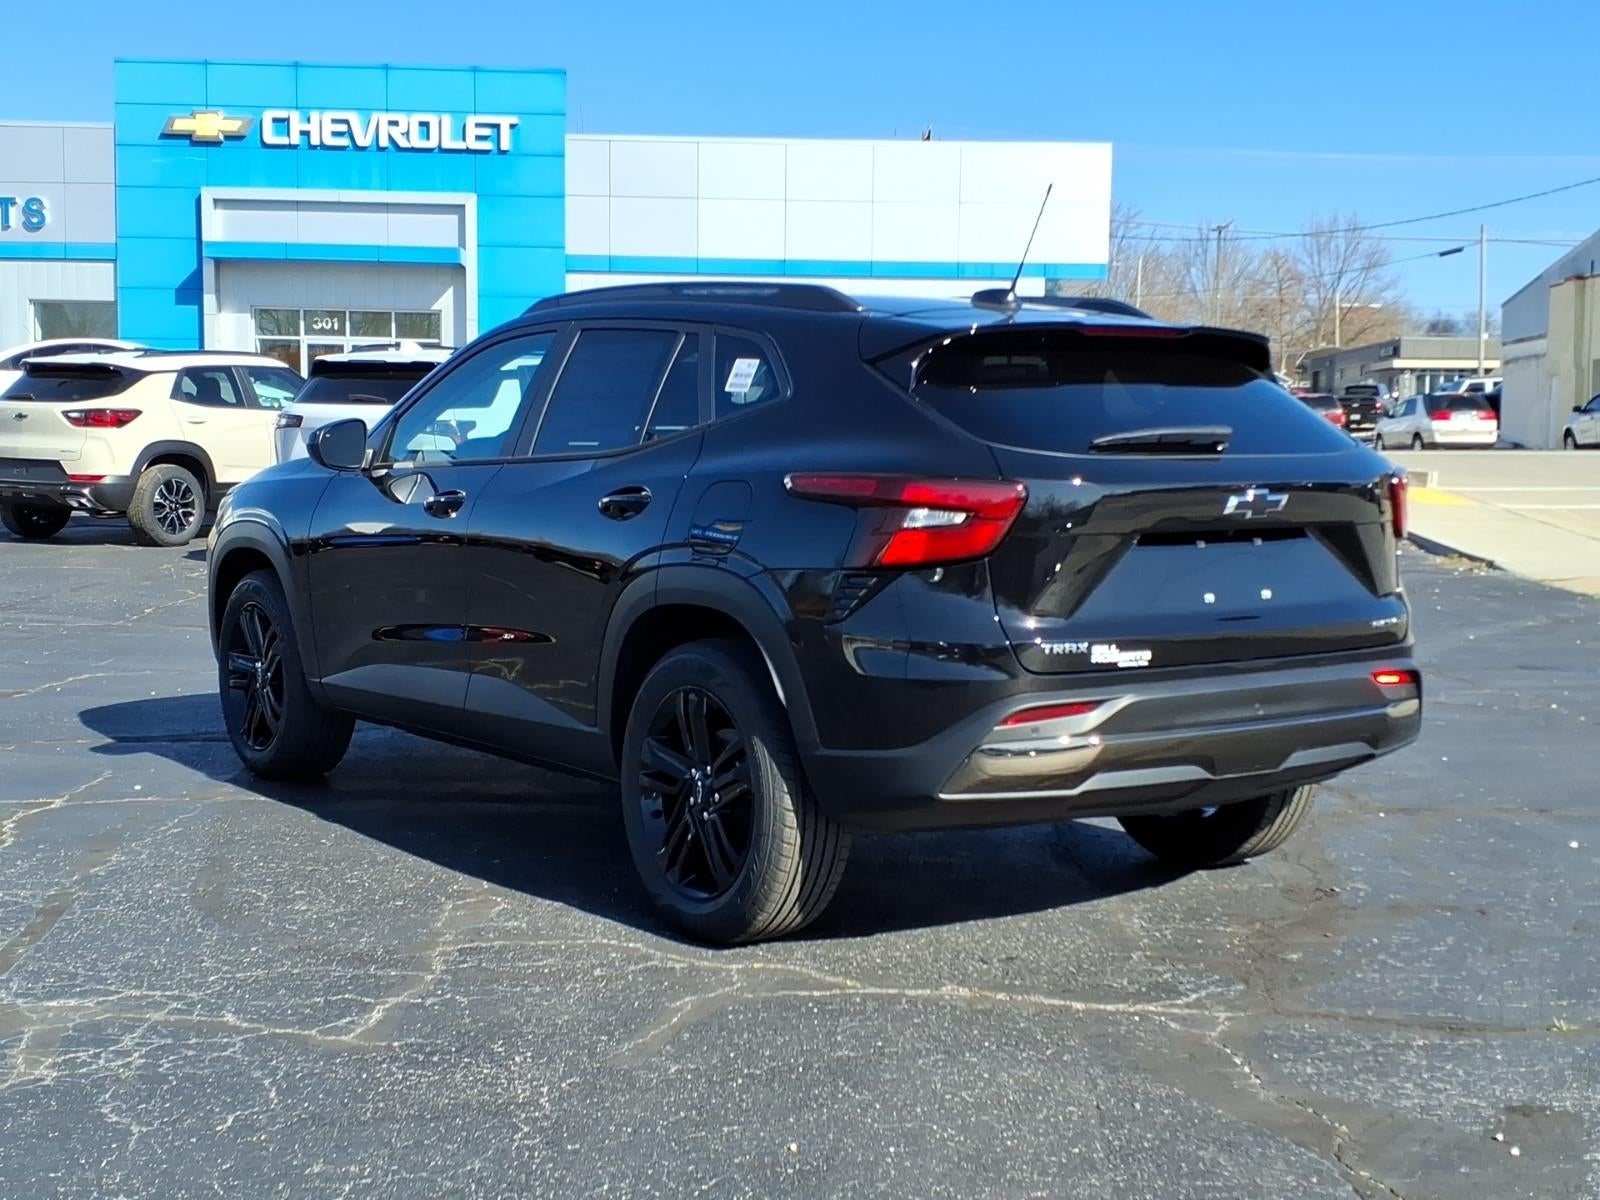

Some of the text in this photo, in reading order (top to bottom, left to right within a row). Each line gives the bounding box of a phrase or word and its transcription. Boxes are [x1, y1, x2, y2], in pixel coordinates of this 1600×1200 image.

[261, 109, 519, 153] CHEVROLET
[312, 317, 339, 331] 301
[1041, 642, 1088, 655] TRAX
